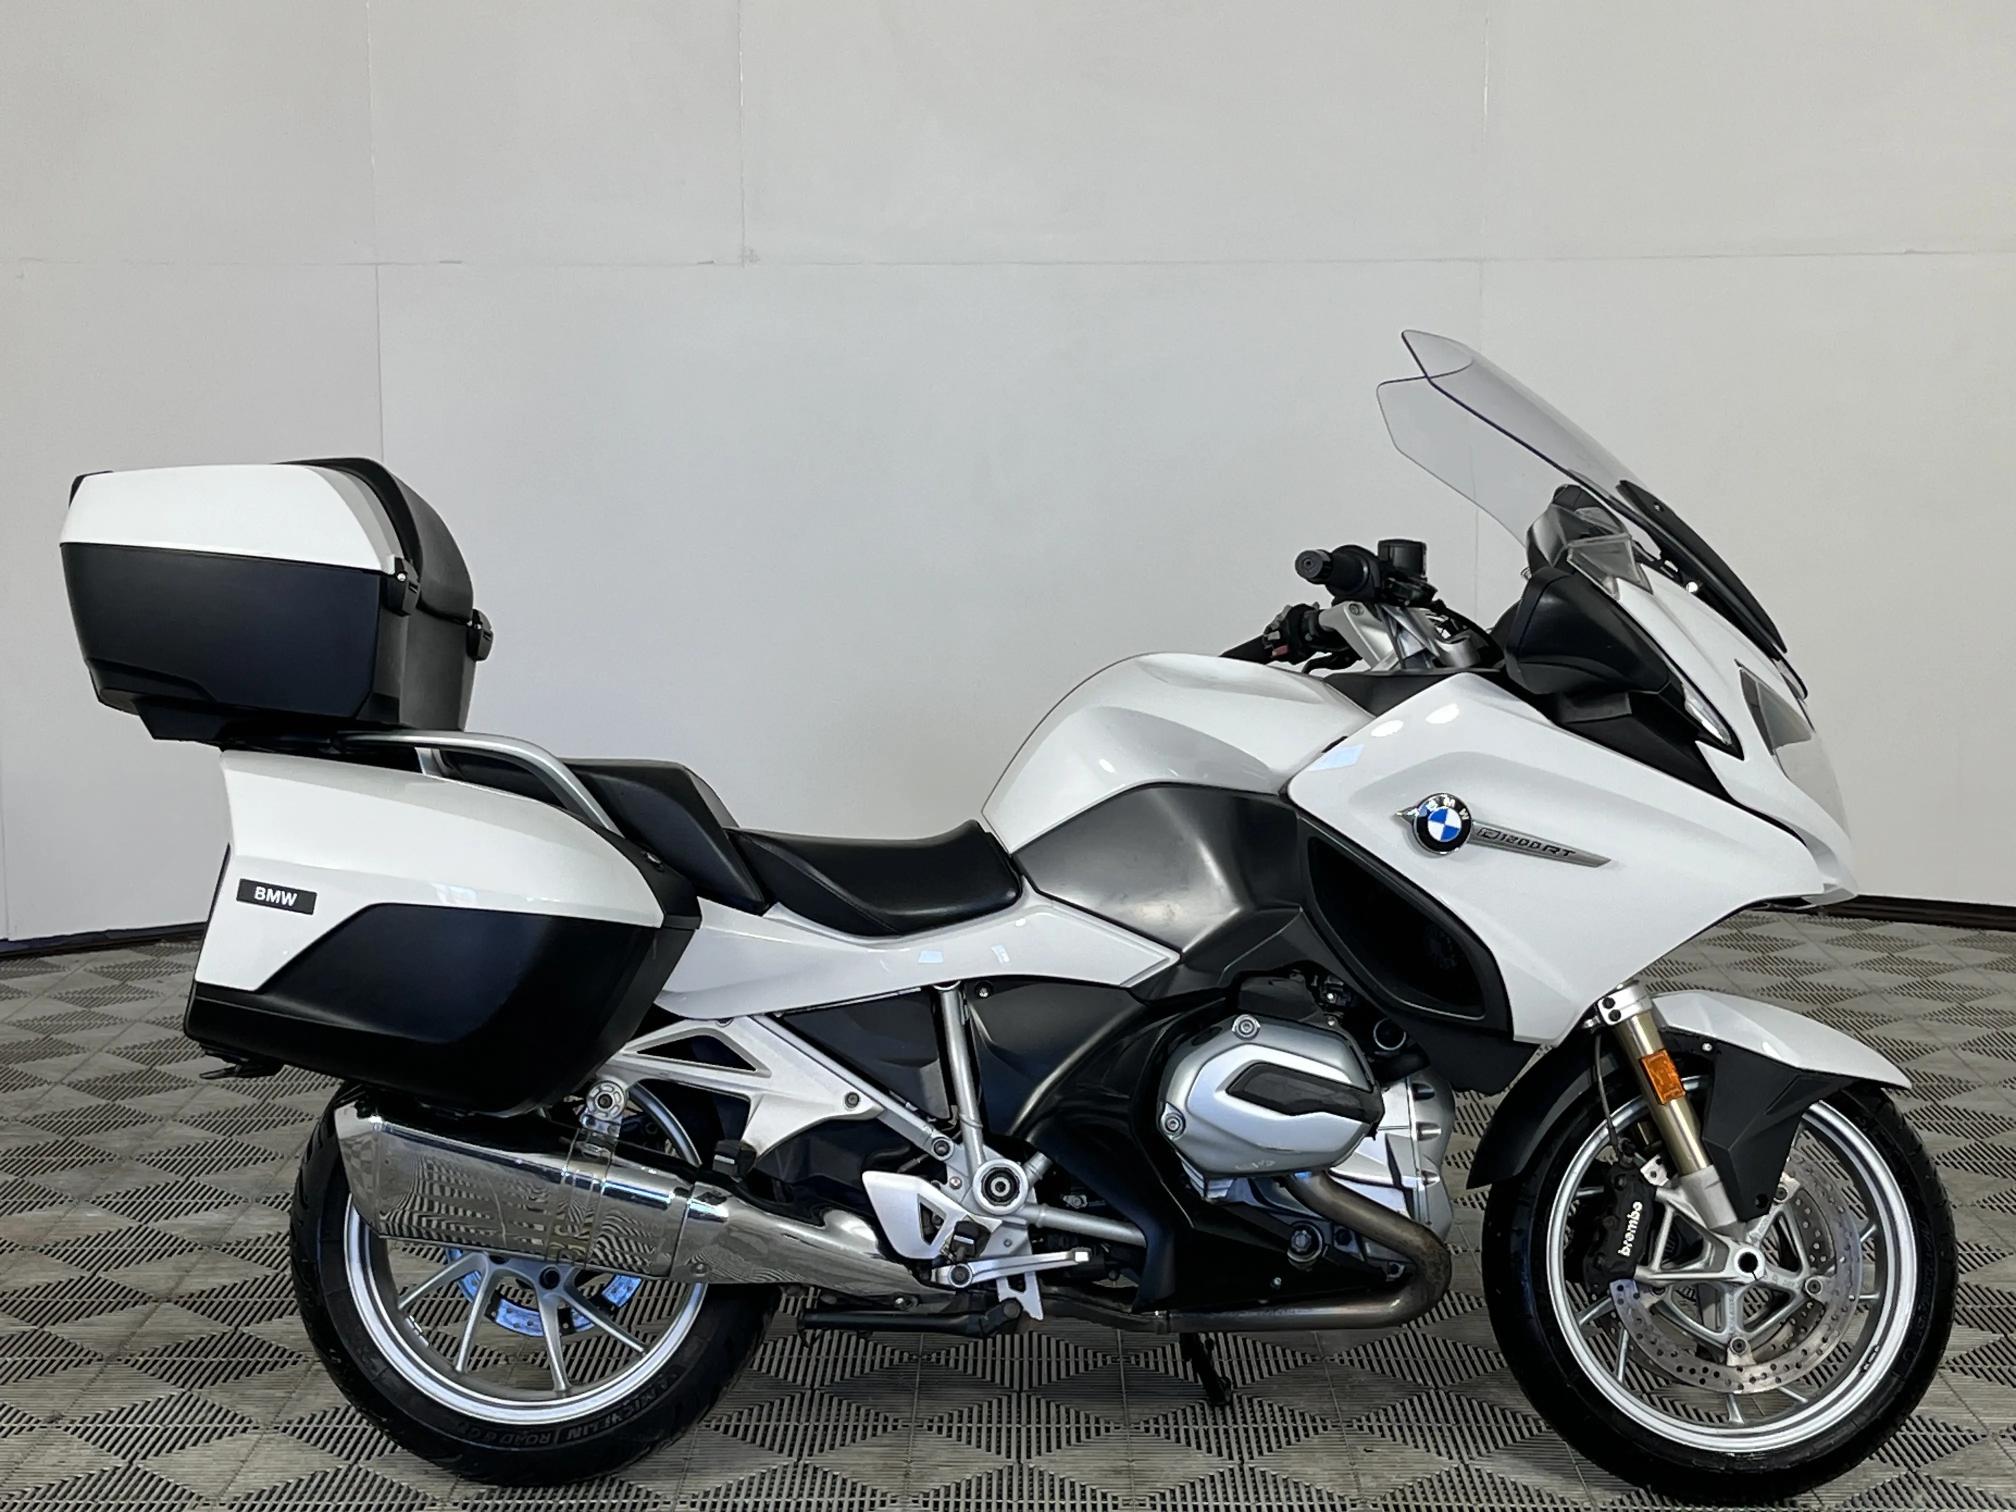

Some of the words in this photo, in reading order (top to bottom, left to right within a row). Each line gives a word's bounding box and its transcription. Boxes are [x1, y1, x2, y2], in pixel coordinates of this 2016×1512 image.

[1426, 796, 1470, 820] BMW
[254, 886, 298, 906] BMW
[1617, 1201, 1643, 1257] brembo
[567, 1386, 660, 1441] MICHELIN
[500, 1431, 551, 1445] ROAD
